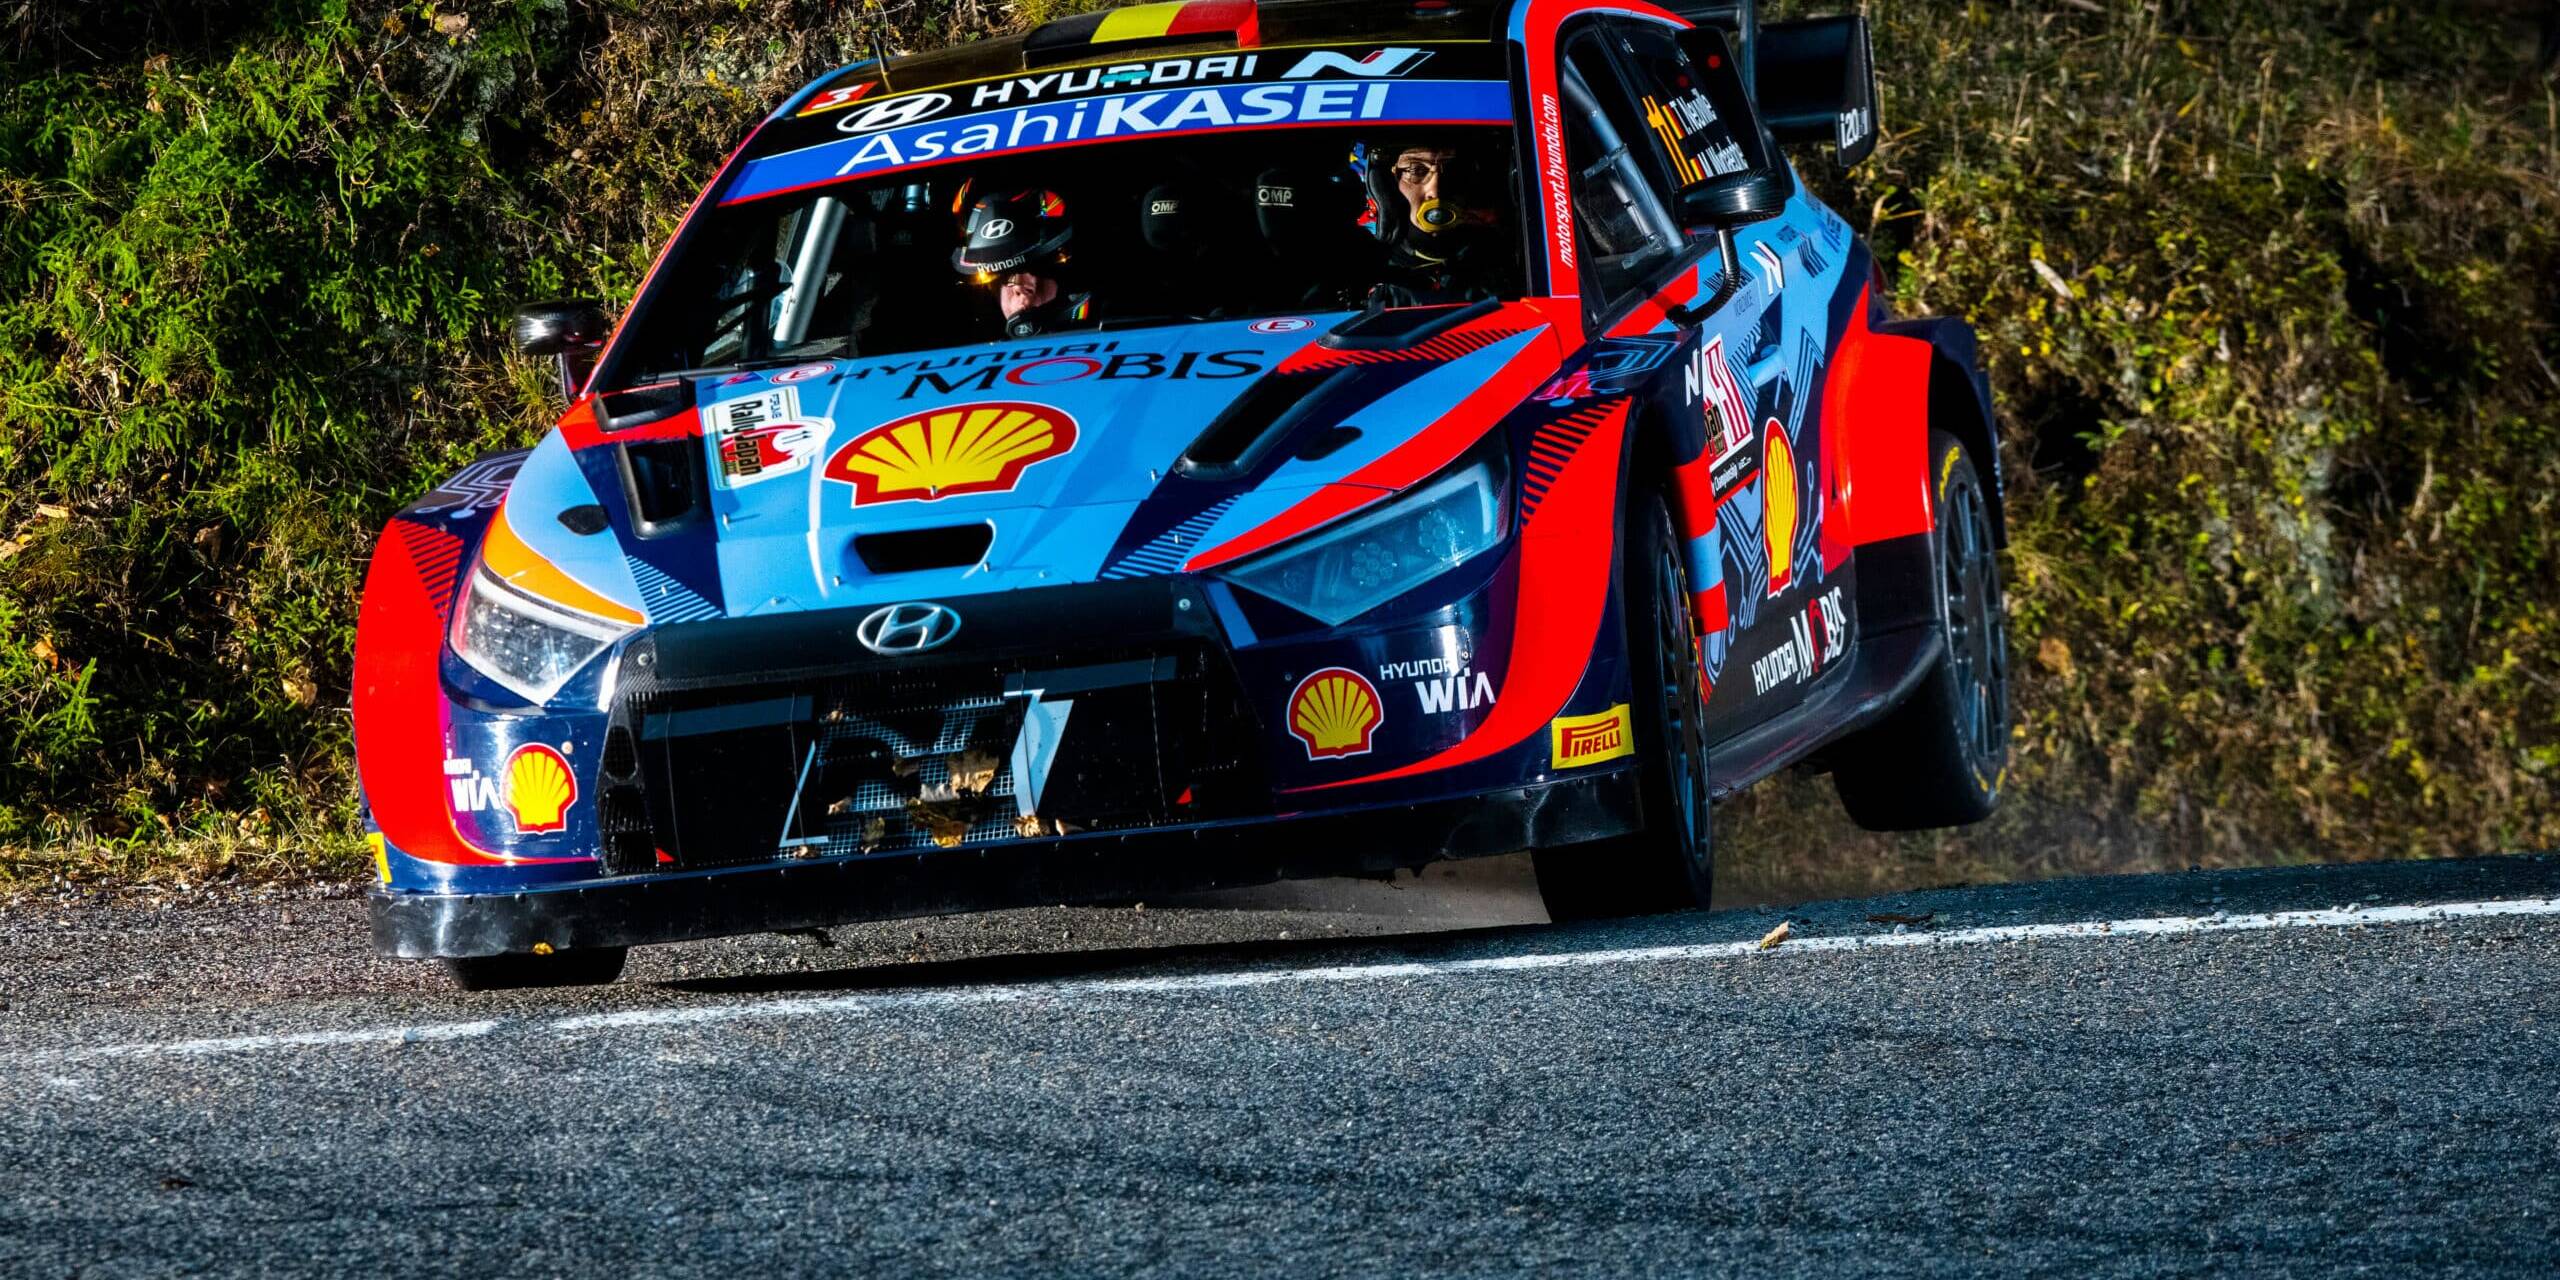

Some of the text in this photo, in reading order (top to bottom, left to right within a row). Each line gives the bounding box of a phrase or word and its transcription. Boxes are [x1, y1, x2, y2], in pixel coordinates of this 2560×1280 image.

[971, 55, 1258, 107] HYUNDAI
[836, 83, 1389, 176] AsahiKASEI
[1258, 187, 1293, 203] OMP
[1540, 94, 1573, 269] motorsport.hyundai.com
[1151, 201, 1178, 214] OMP
[976, 255, 1026, 274] HYUNDAI
[827, 341, 1120, 386] HYUNDAI
[896, 350, 1264, 400] MOBIS
[722, 400, 769, 477] Rally Japan
[1790, 586, 1847, 684] MOBIS
[1752, 640, 1799, 697] HYUNDAI
[1561, 716, 1621, 758] PIRELLI
